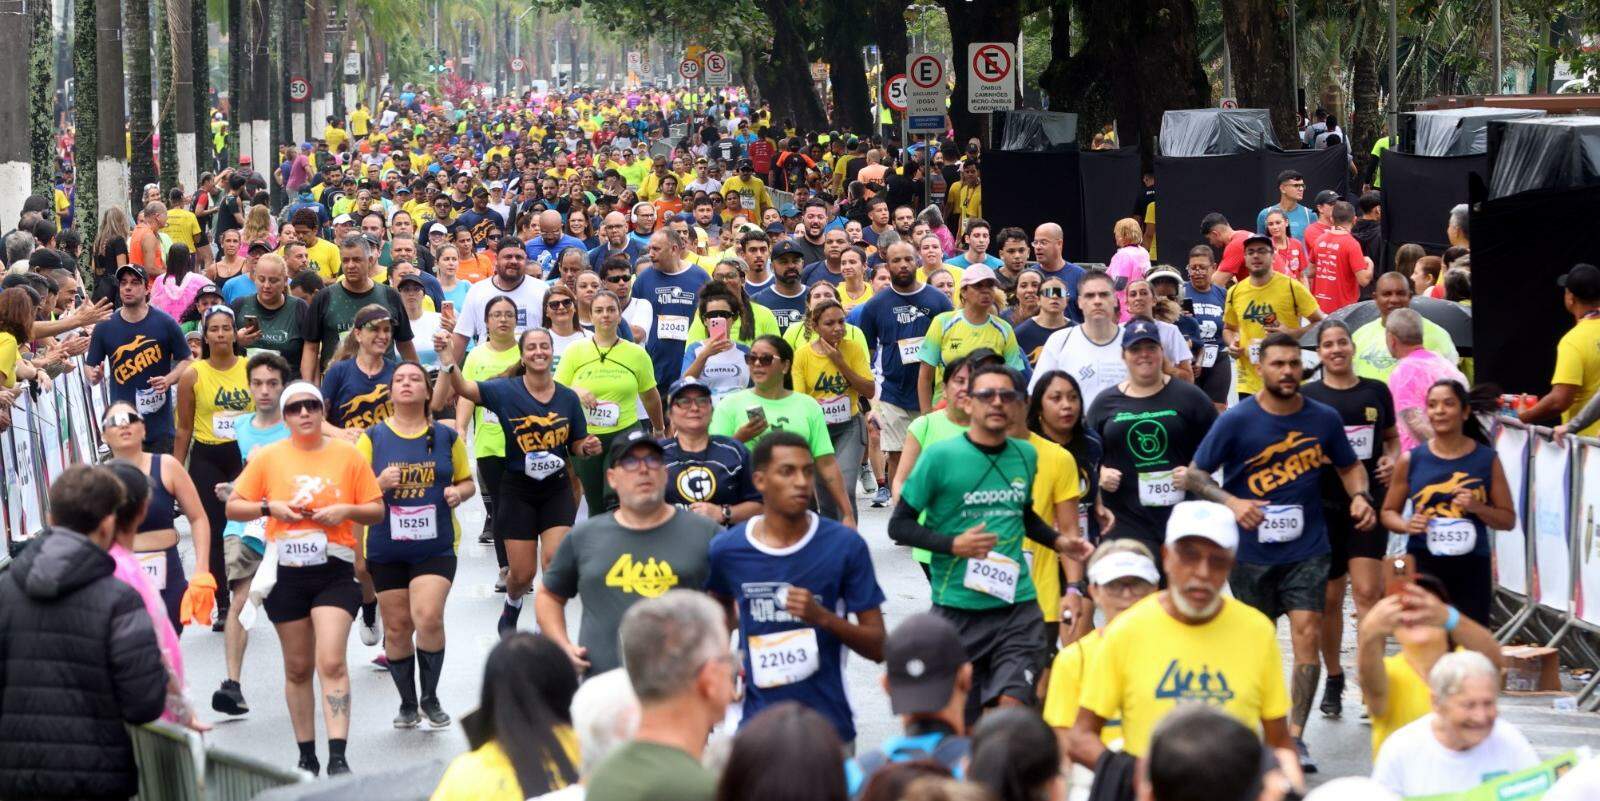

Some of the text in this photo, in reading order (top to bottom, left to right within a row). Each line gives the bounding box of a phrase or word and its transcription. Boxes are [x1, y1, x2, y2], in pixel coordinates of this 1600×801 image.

[684, 63, 697, 72] 50
[984, 52, 999, 75] E
[920, 62, 932, 81] E
[292, 83, 306, 94] 50
[660, 323, 686, 332] 22043
[589, 405, 612, 418] 17212
[822, 403, 846, 415] 14614
[531, 459, 561, 471] 25632
[394, 488, 426, 500] 2026
[399, 517, 429, 528] 15251
[1263, 518, 1298, 529] 26510
[1430, 530, 1470, 542] 26537
[285, 542, 319, 554] 21156
[972, 561, 1015, 587] 20206
[760, 647, 808, 669] 22163
